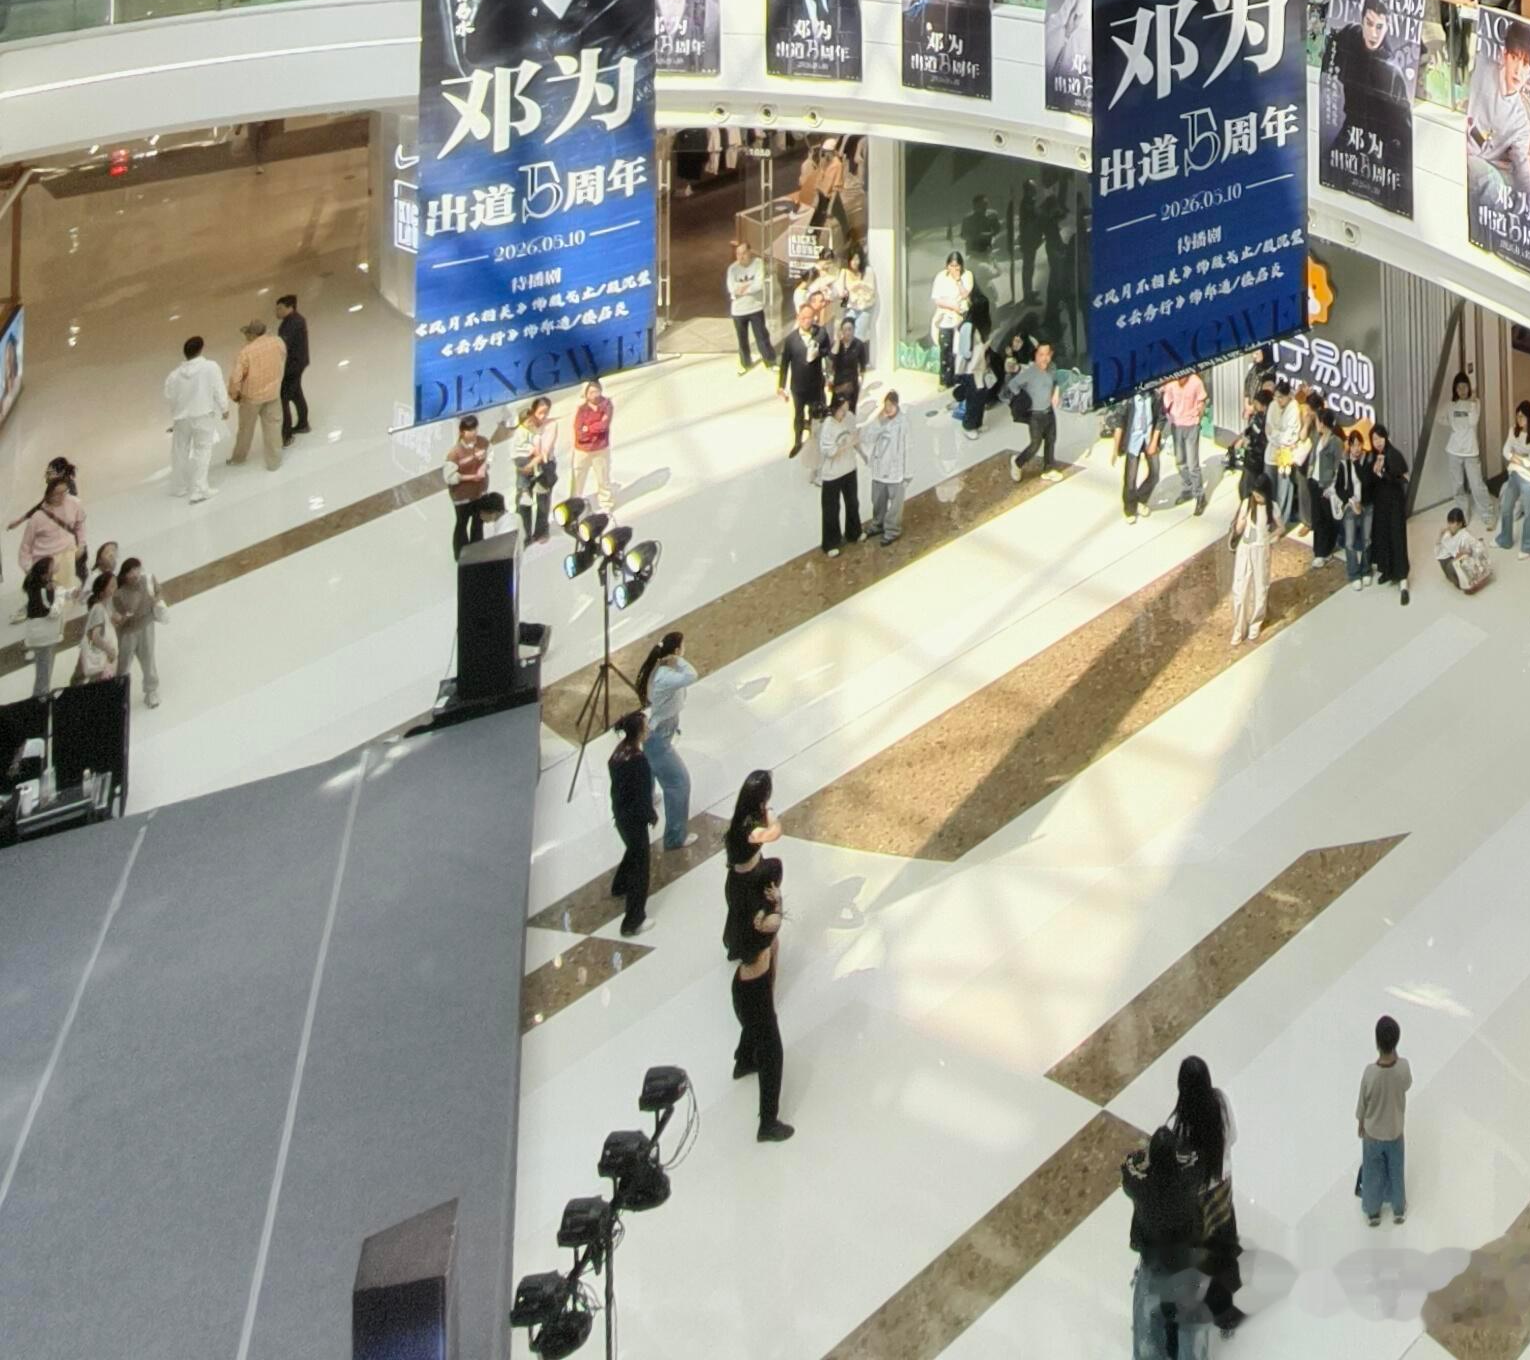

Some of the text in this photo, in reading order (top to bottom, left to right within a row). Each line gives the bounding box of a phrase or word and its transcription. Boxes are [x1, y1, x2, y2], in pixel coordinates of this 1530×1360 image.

[793, 19, 832, 42] 邓为
[926, 32, 963, 55] 邓为
[437, 48, 638, 159] 邓为
[1099, 104, 1300, 197] 出道5周年
[1347, 126, 1383, 158] 邓为
[426, 156, 648, 237] 出道5周年
[1160, 183, 1242, 221] 2026.05.10
[494, 230, 586, 263] 2026.05.10
[416, 328, 657, 420] DENGWEI
